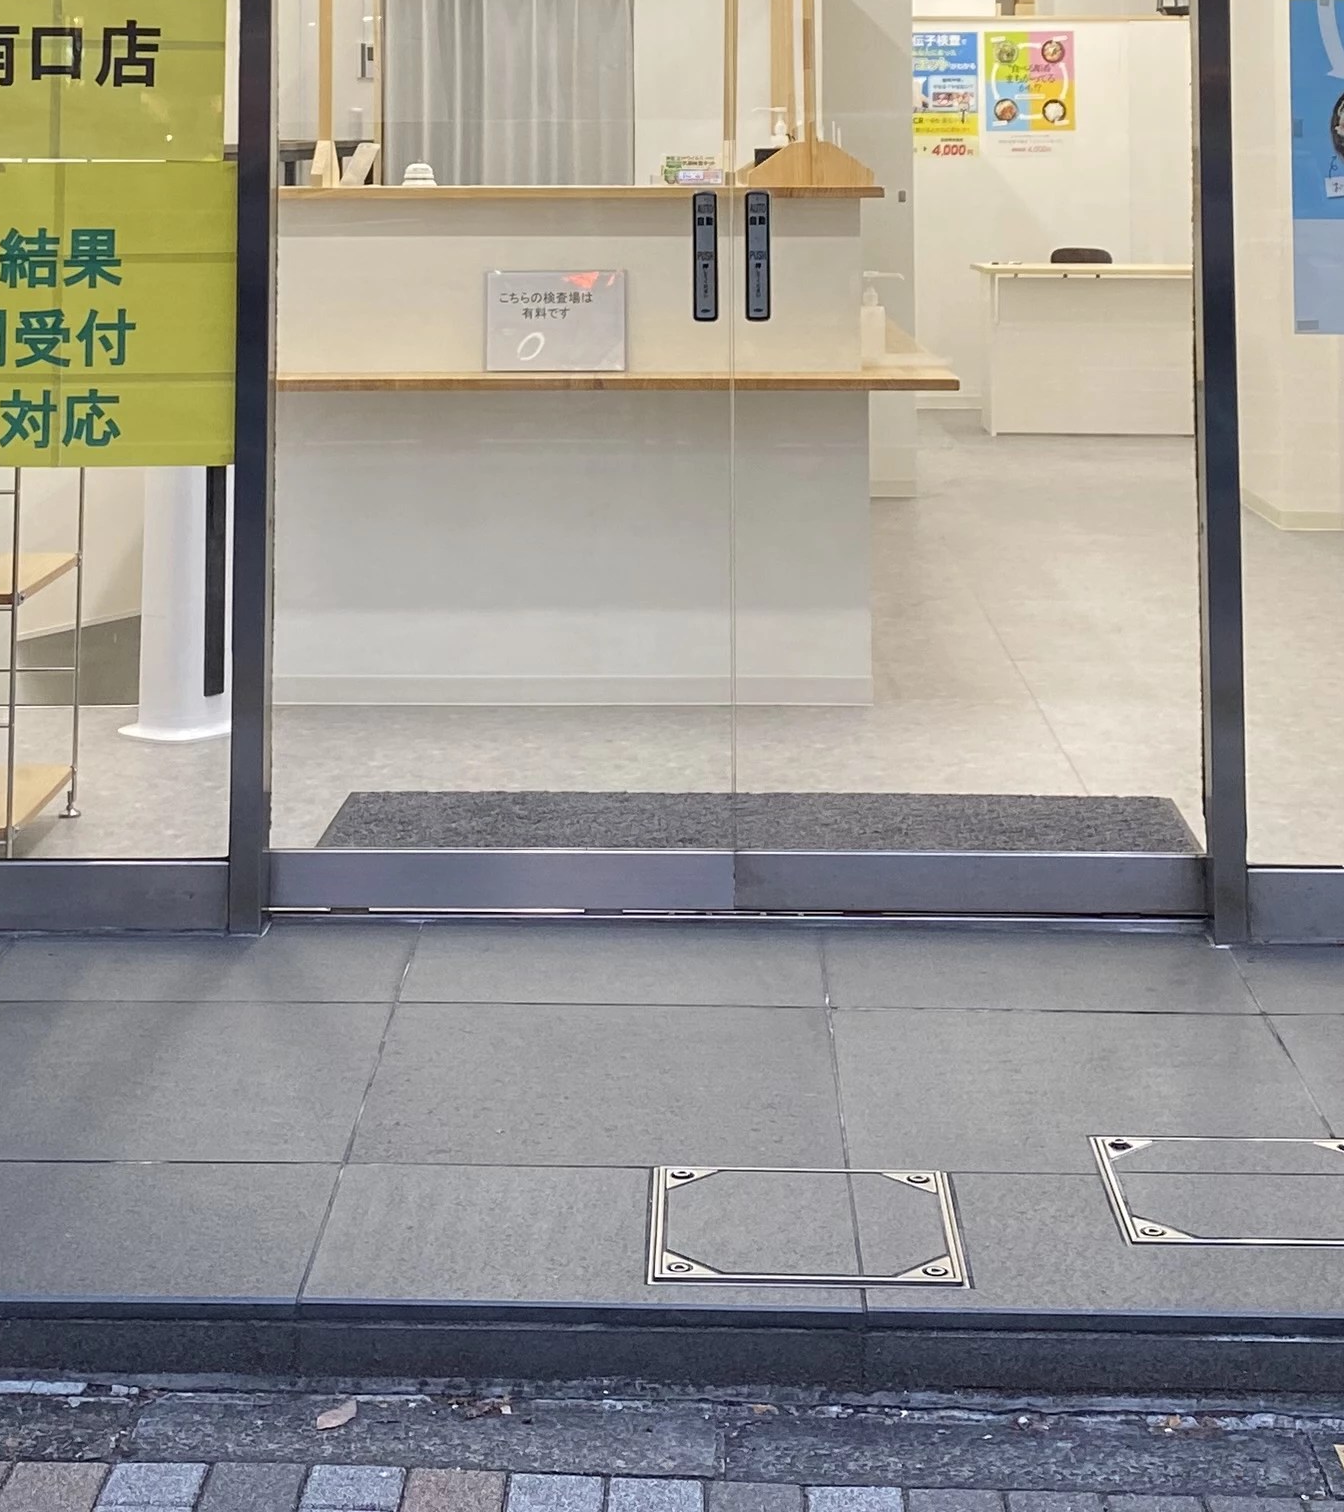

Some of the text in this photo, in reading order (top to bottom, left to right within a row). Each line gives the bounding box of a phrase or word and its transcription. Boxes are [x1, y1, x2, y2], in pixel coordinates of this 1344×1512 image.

[499, 291, 593, 305] こちらの検査場は
[522, 307, 571, 320] 有料です
